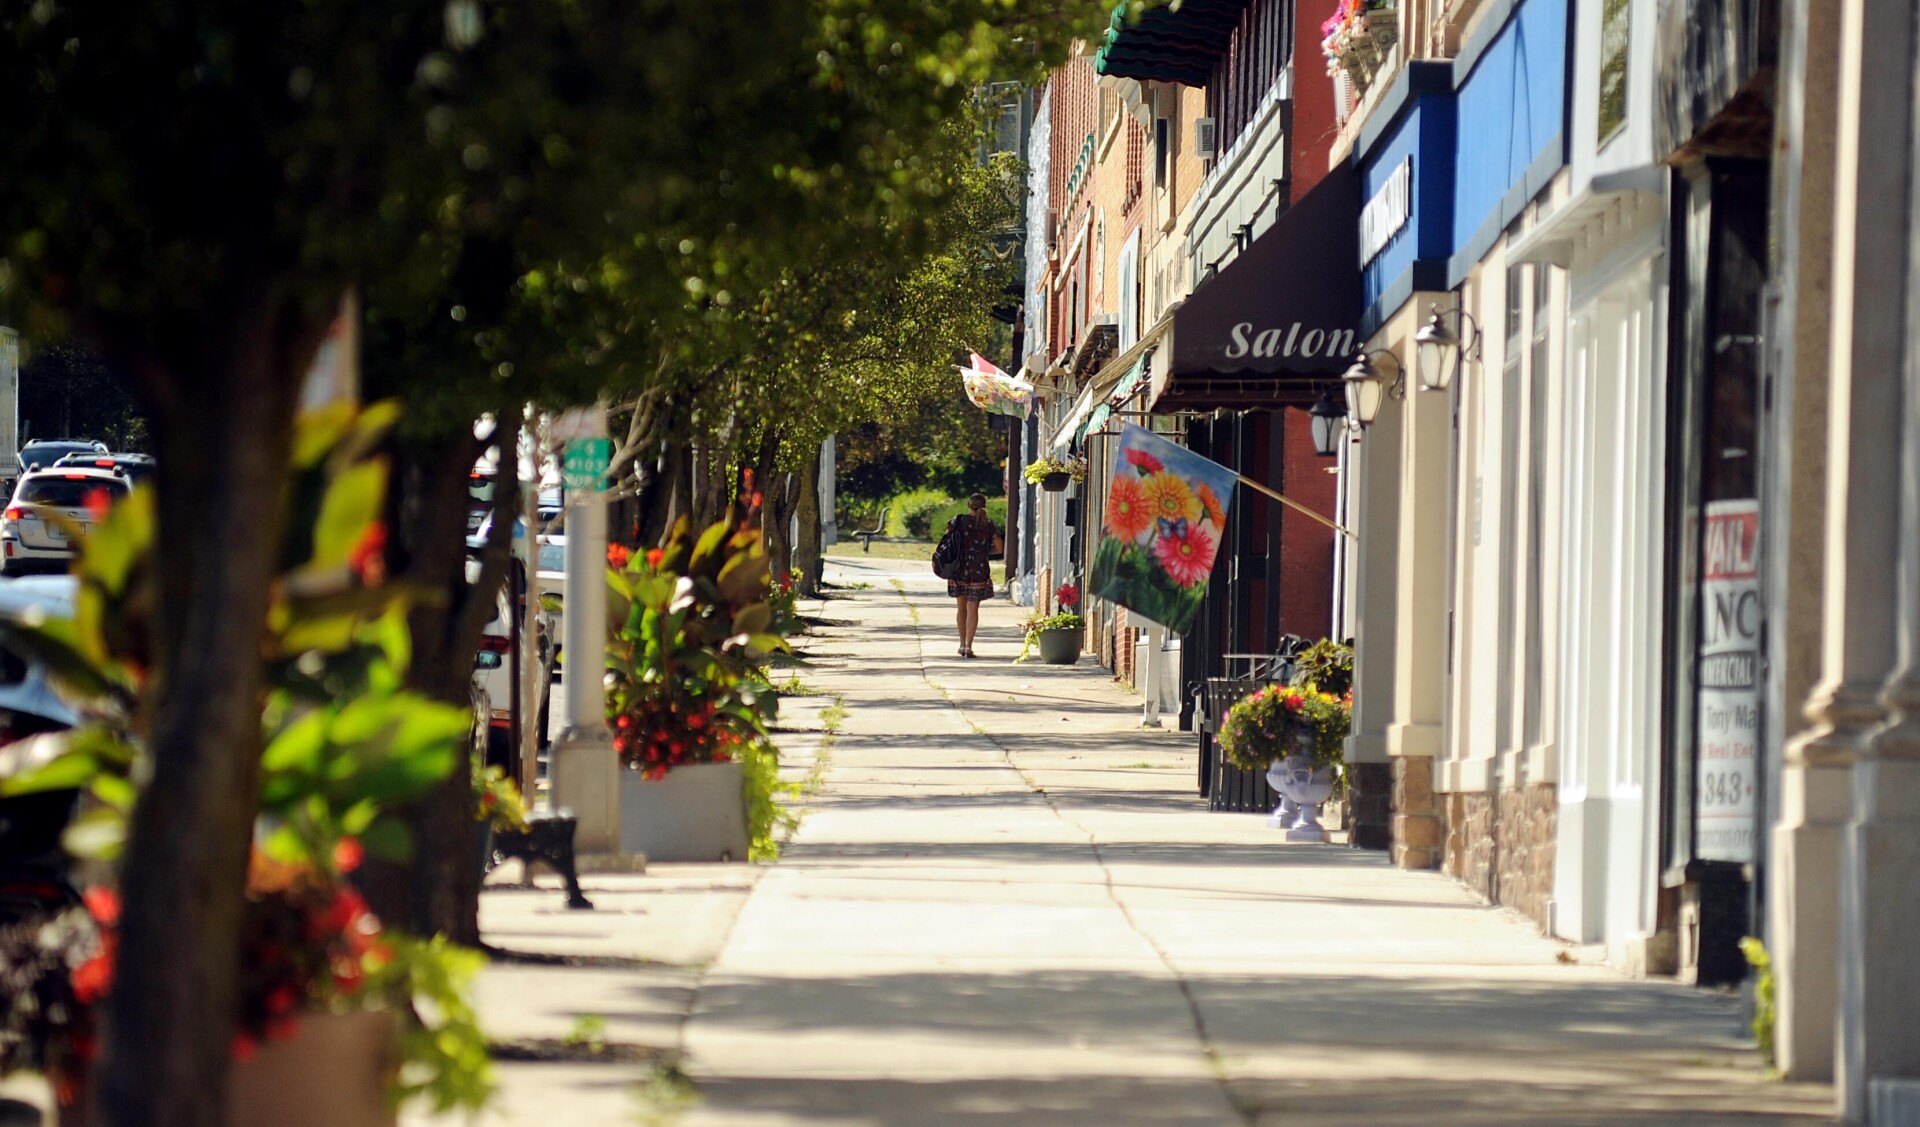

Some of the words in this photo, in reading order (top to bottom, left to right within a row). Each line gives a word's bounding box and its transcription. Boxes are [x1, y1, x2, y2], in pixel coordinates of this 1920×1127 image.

[1225, 321, 1355, 358] Salon
[1706, 706, 1732, 734] Tony
[1705, 771, 1743, 806] 343
